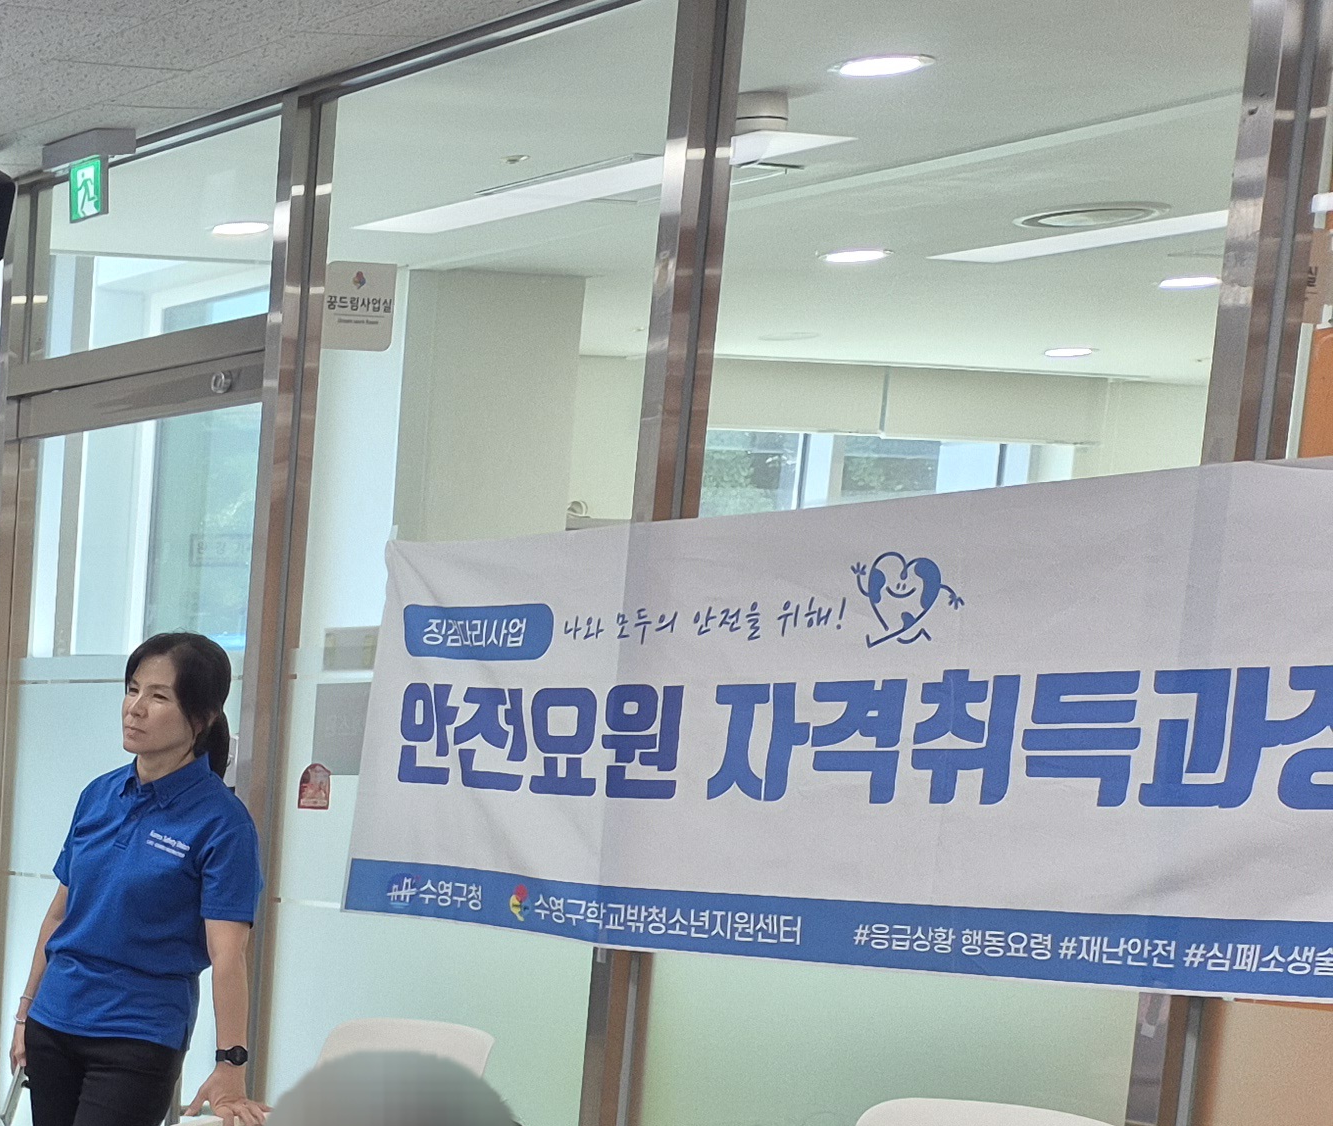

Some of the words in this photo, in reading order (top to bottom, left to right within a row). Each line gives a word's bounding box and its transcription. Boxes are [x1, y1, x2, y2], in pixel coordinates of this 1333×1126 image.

[327, 295, 393, 313] 꿈드림사업실
[422, 616, 527, 648] 징검다리사업
[563, 614, 604, 641] 나와
[616, 607, 676, 645] 모두의
[693, 601, 761, 641] 안전을
[777, 597, 848, 635] 위해!
[397, 682, 685, 799] 안전요원
[419, 881, 483, 911] 수영구청
[534, 893, 801, 946] 수영구학교밖청소년지원센터
[853, 923, 955, 954] #응급상황
[961, 929, 1052, 961] 행동요령
[1058, 935, 1176, 969] #재난안전
[1183, 942, 1333, 976] #심폐소생술
